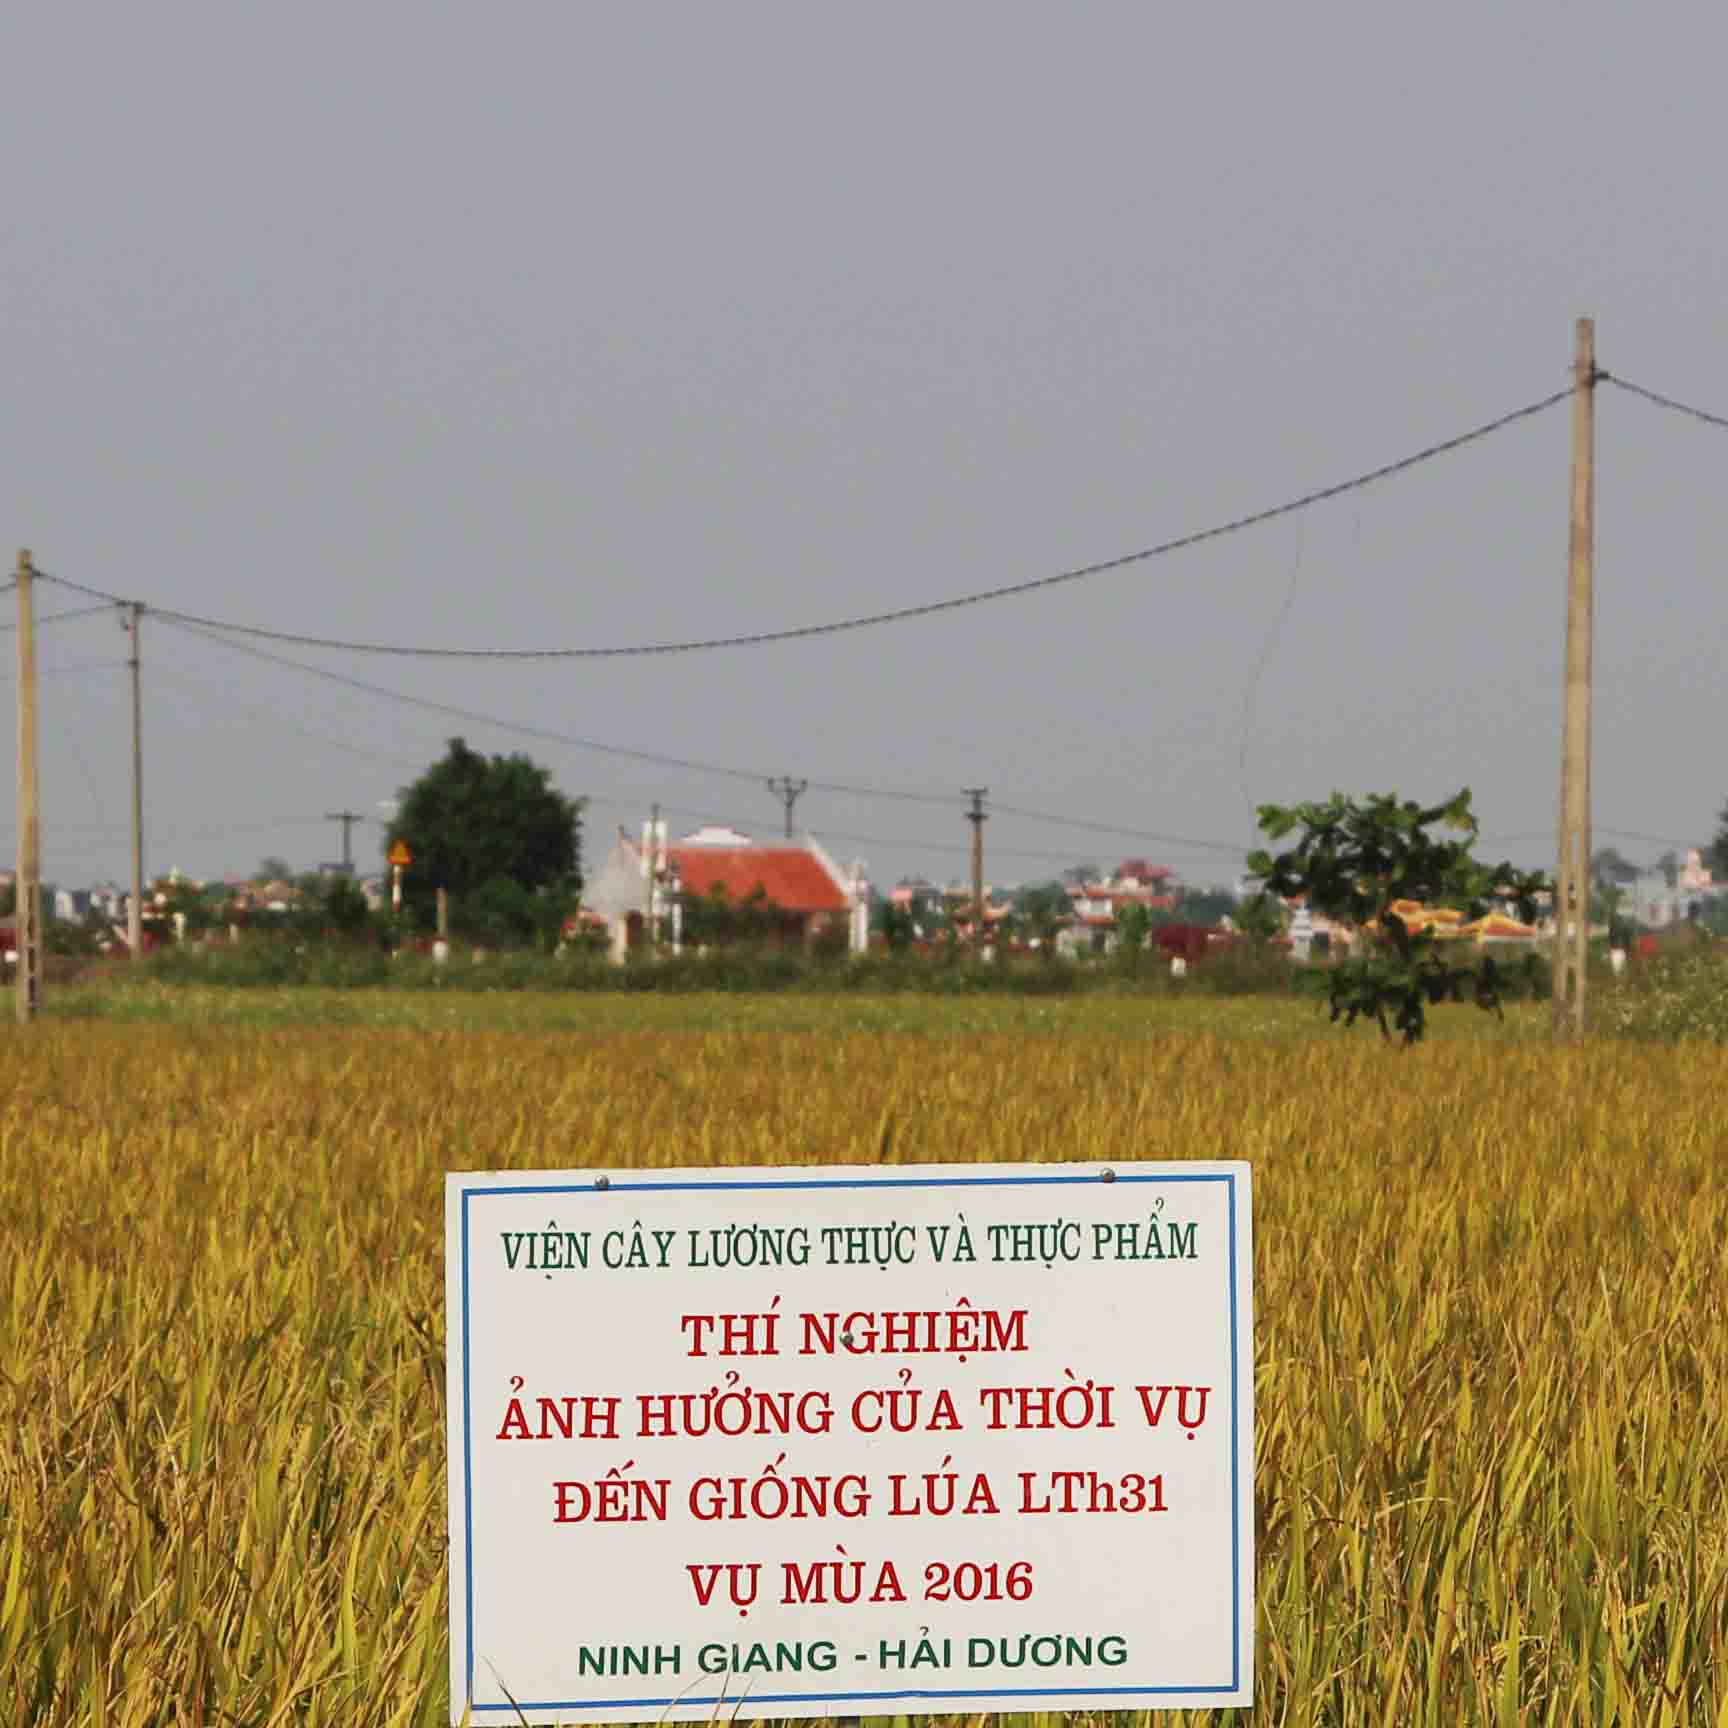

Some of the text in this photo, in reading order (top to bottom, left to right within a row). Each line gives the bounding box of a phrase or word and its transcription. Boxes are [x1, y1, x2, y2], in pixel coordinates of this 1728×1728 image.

[501, 1197, 1199, 1280] VIỆN CÂY LƯƠNG THỰC VÀ THỰC PHẨM
[680, 1294, 1029, 1364] THÍ NGHIỆM
[495, 1367, 1213, 1441] ẢNH HƯỞNG CỦA THỜI VỤ
[552, 1451, 1169, 1525] ĐẾN GIỐNG LÚA LTh31
[685, 1543, 1034, 1618] VỤ MÙA 2016
[578, 1645, 682, 1677] NINH
[697, 1640, 837, 1676] GIANG
[878, 1625, 952, 1671] HẢI
[967, 1633, 1129, 1669] DƯƠNG
